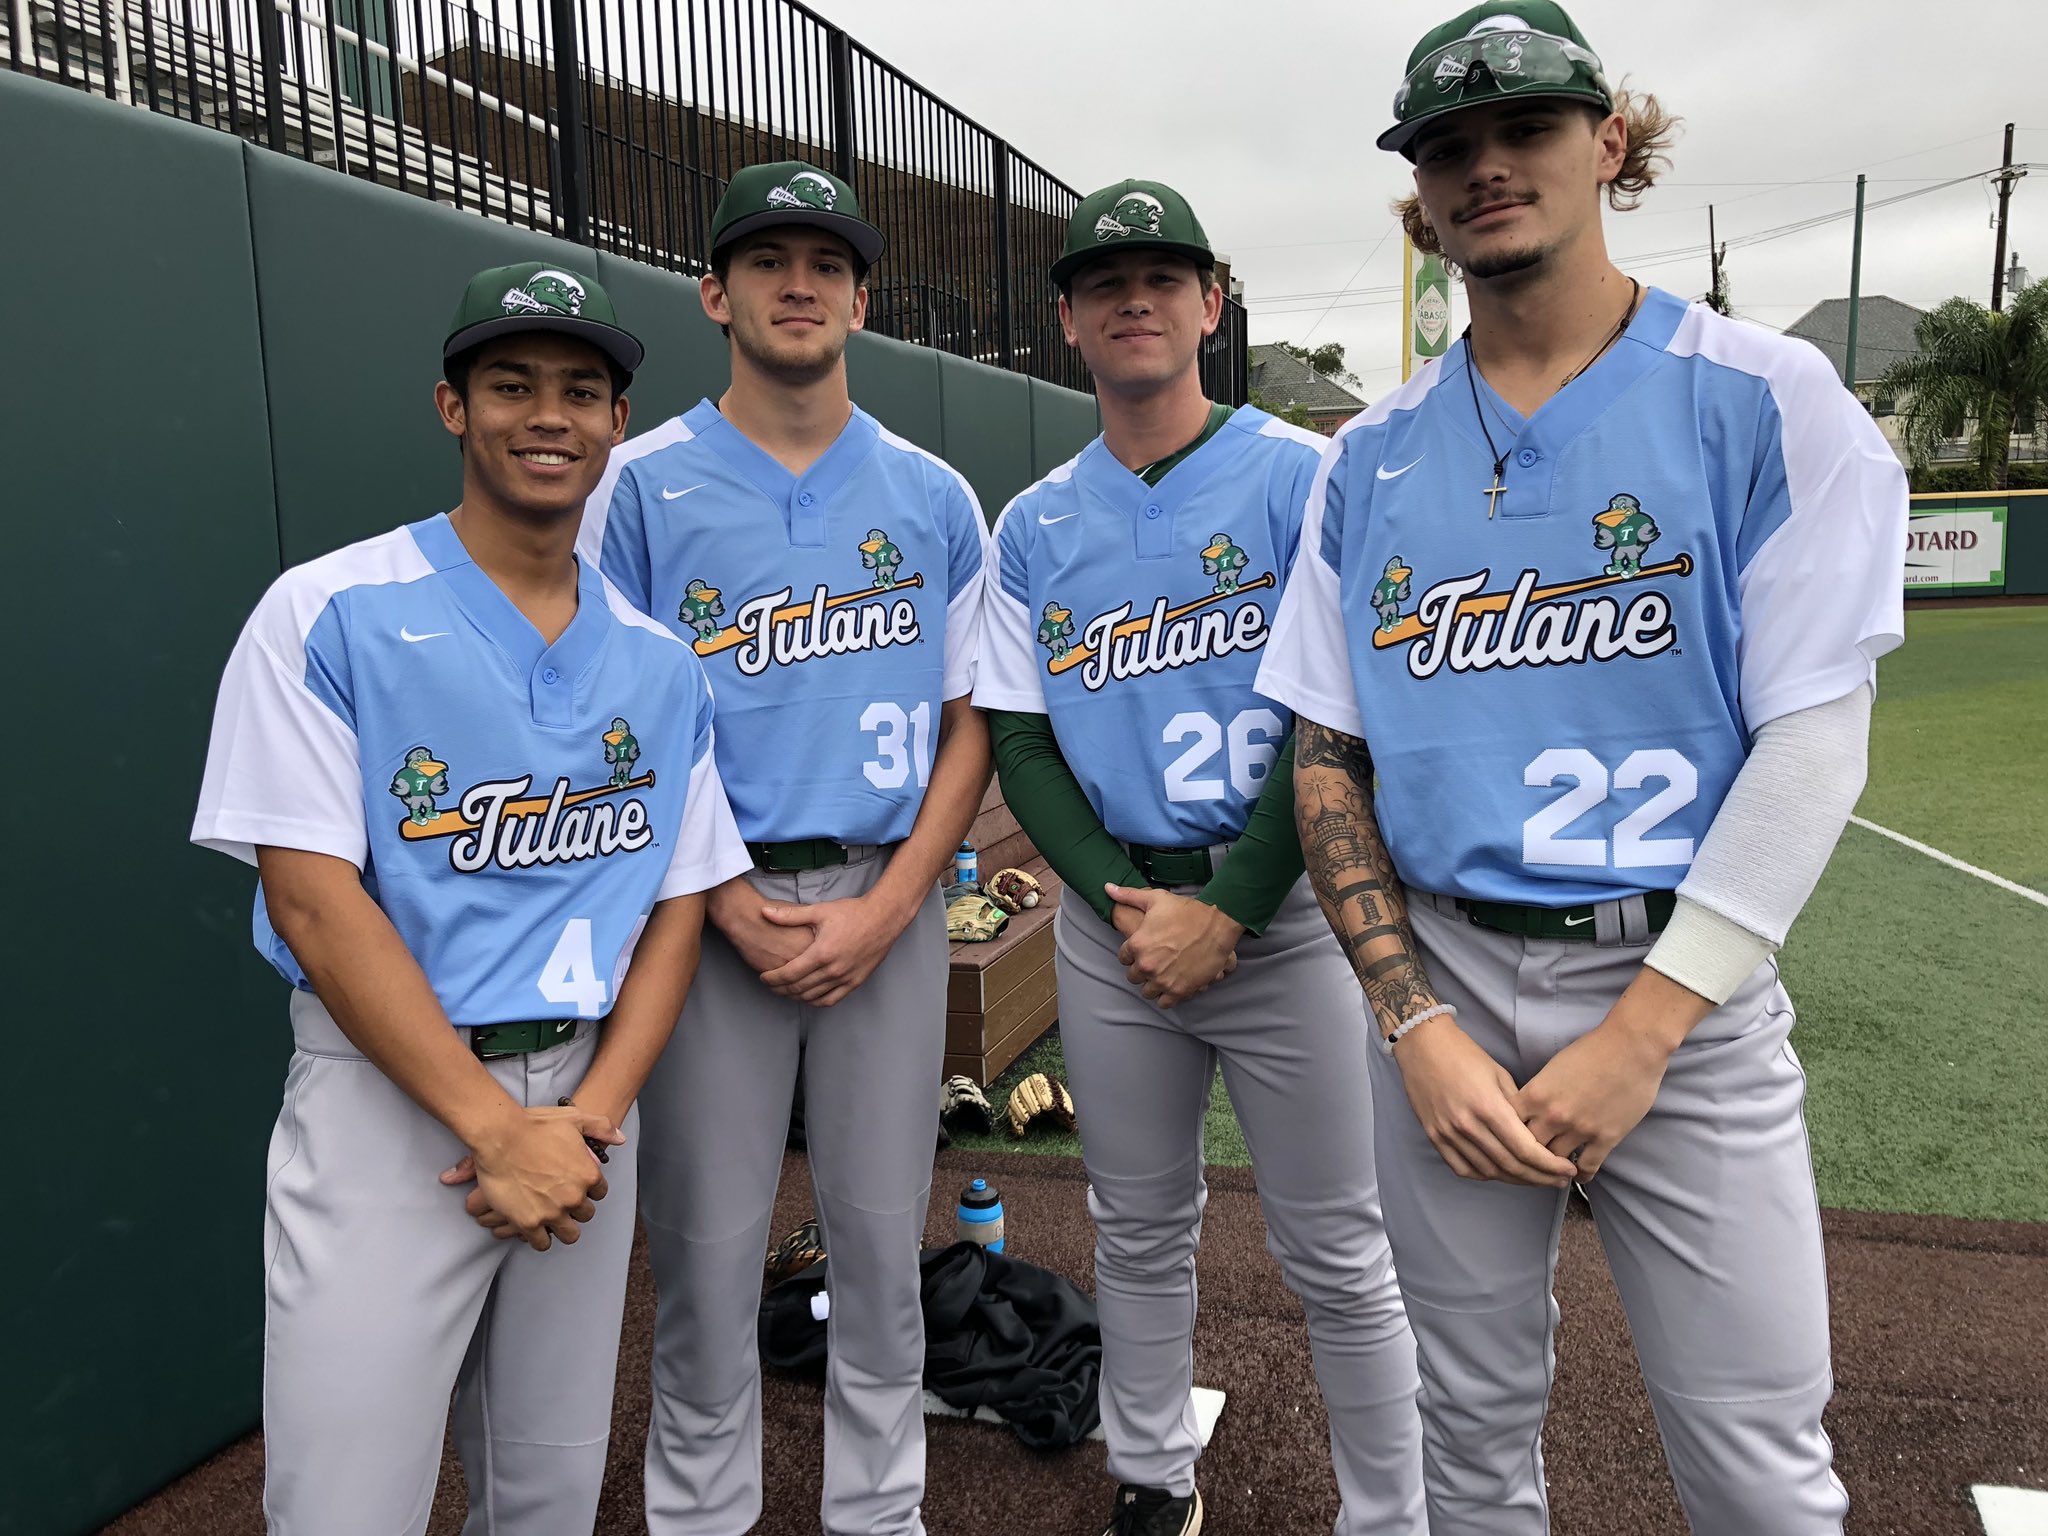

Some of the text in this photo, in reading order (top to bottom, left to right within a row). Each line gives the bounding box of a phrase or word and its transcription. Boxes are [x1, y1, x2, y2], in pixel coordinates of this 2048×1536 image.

[735, 584, 920, 676] Tulane
[1081, 597, 1270, 692] Tulane
[1407, 568, 1677, 679] Tulane
[859, 701, 930, 789] 31
[1163, 708, 1283, 802] 26
[450, 774, 654, 873] Tulane
[1523, 748, 1698, 868] 22
